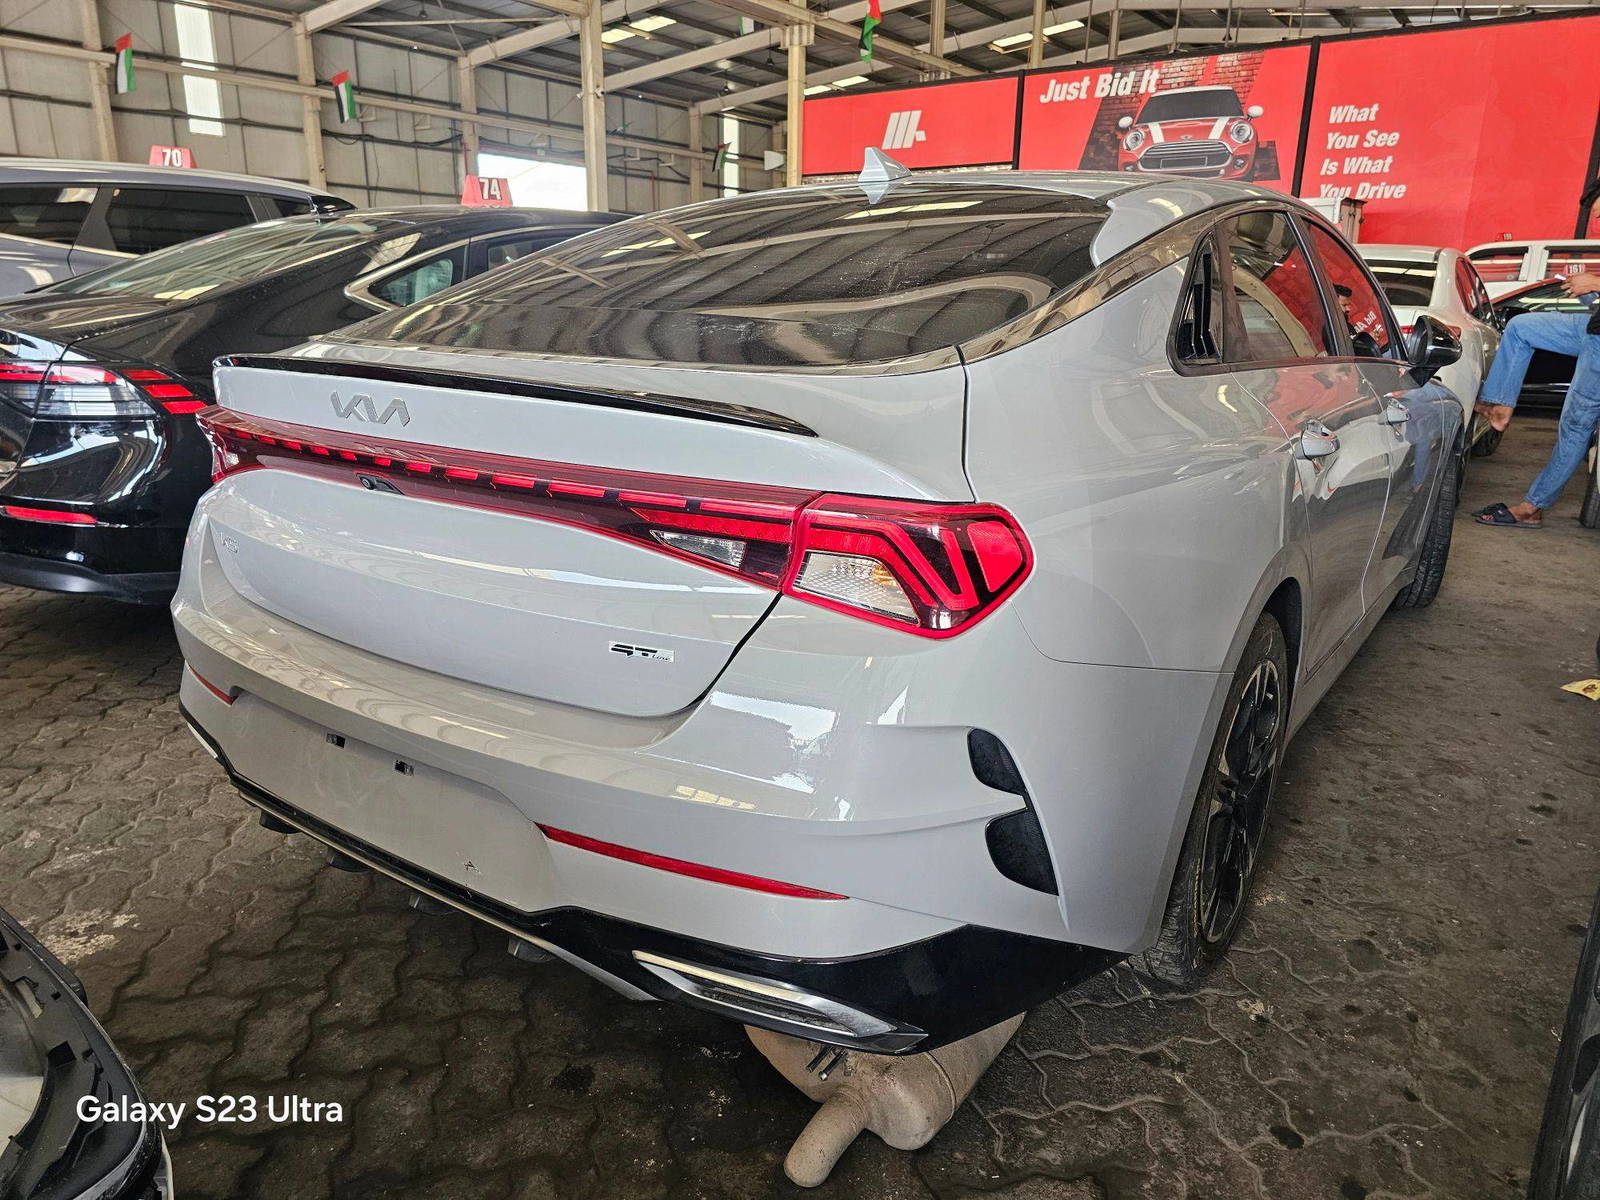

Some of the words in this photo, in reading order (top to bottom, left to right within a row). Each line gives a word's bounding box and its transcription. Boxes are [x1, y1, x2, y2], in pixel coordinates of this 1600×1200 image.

[1040, 75, 1090, 103] Just
[1094, 71, 1136, 98] Bid
[1139, 69, 1160, 93] It
[1329, 103, 1379, 124] What
[1326, 132, 1360, 150] You
[1363, 129, 1400, 148] See
[162, 149, 182, 167] 70
[1320, 159, 1339, 176] Is
[1343, 156, 1393, 175] What
[479, 178, 502, 200] 74
[1320, 184, 1352, 199] You
[1355, 181, 1407, 199] Drive
[330, 391, 411, 427] KIA
